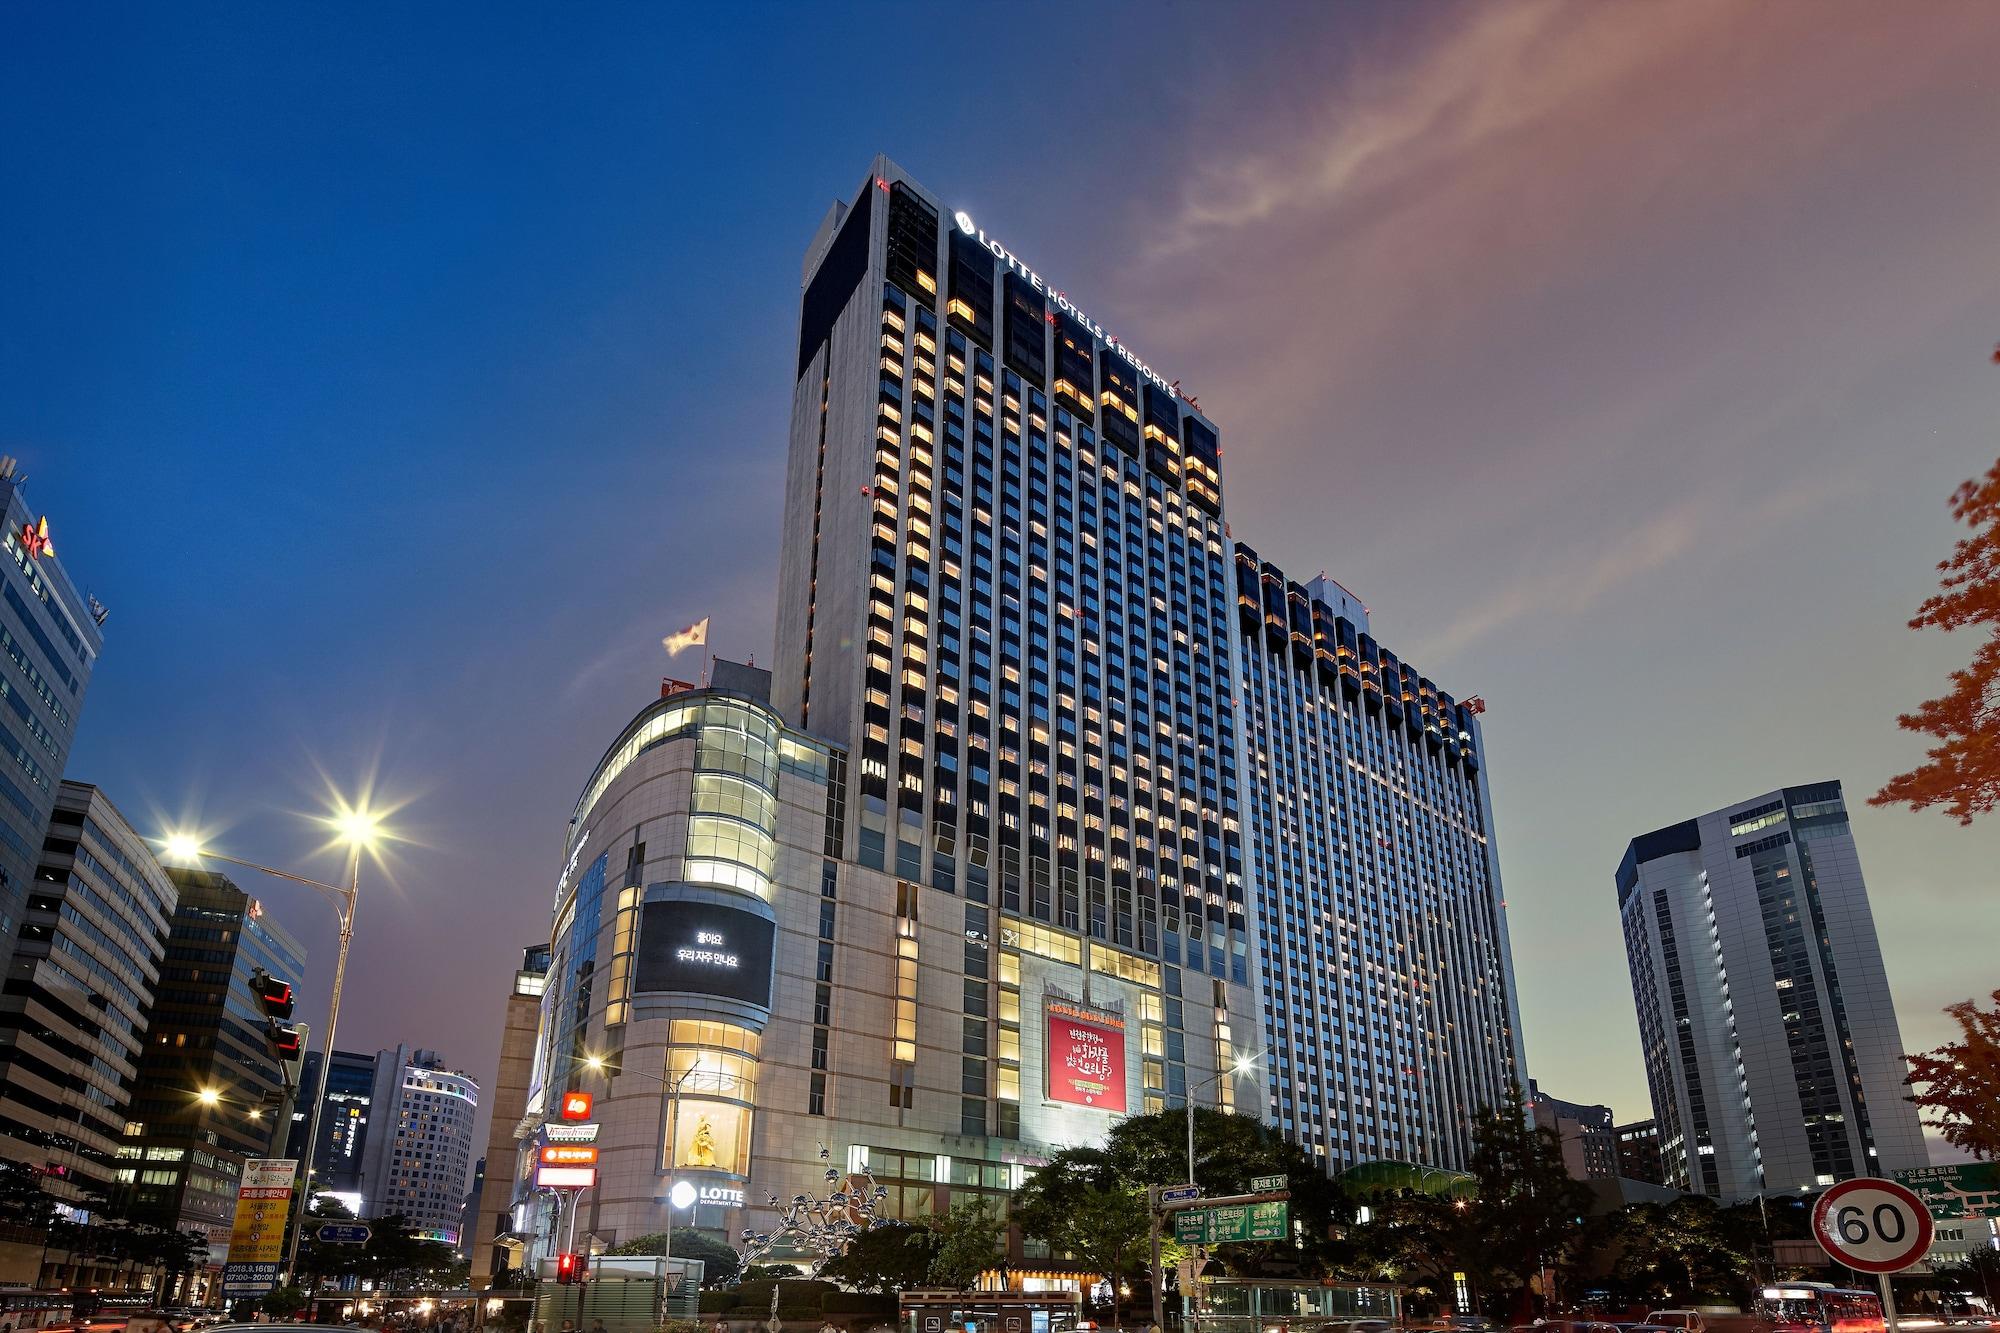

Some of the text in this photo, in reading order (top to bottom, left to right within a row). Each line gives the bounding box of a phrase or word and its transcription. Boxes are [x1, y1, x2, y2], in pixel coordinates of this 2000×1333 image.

[979, 229, 1176, 399] LOTTE HOTELS & RESORTS
[22, 524, 42, 560] SK
[697, 931, 723, 945] 좋아요
[677, 949, 738, 967] 우리 자주 만나요
[1907, 1166, 1958, 1178] 신촌로터리
[1938, 1175, 1963, 1183] Rotary
[1253, 1177, 1283, 1190] 을지로1가
[700, 1187, 743, 1201] LOTTE
[700, 1199, 731, 1207] DEPARTMENT
[1178, 1214, 1204, 1226] 한국은행
[1837, 1203, 1905, 1245] 60
